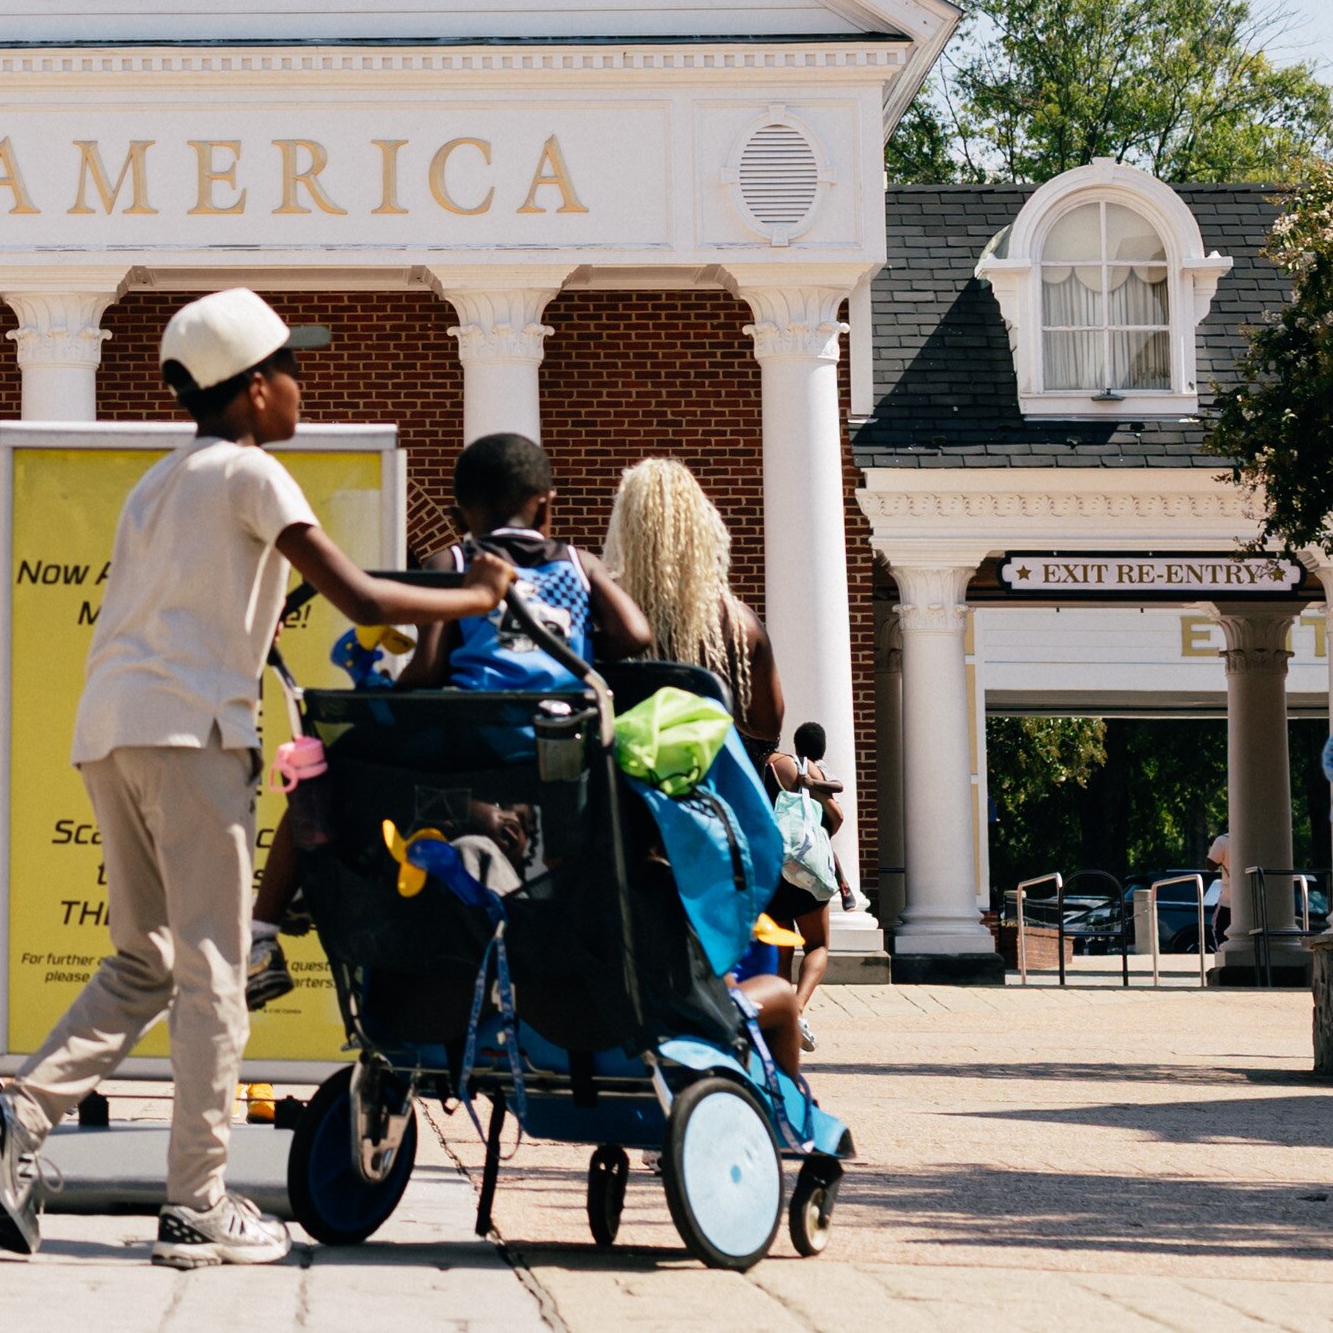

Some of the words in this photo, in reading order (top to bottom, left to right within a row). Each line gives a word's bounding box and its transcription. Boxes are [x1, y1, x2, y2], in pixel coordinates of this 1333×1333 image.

[16, 559, 90, 585] Now
[1042, 564, 1108, 584] EXIT
[1116, 564, 1260, 584] RE-ENTRY
[1180, 615, 1326, 658] ET
[52, 820, 103, 845] Sca
[21, 952, 44, 965] For
[46, 952, 95, 966] further
[44, 971, 90, 984] please
